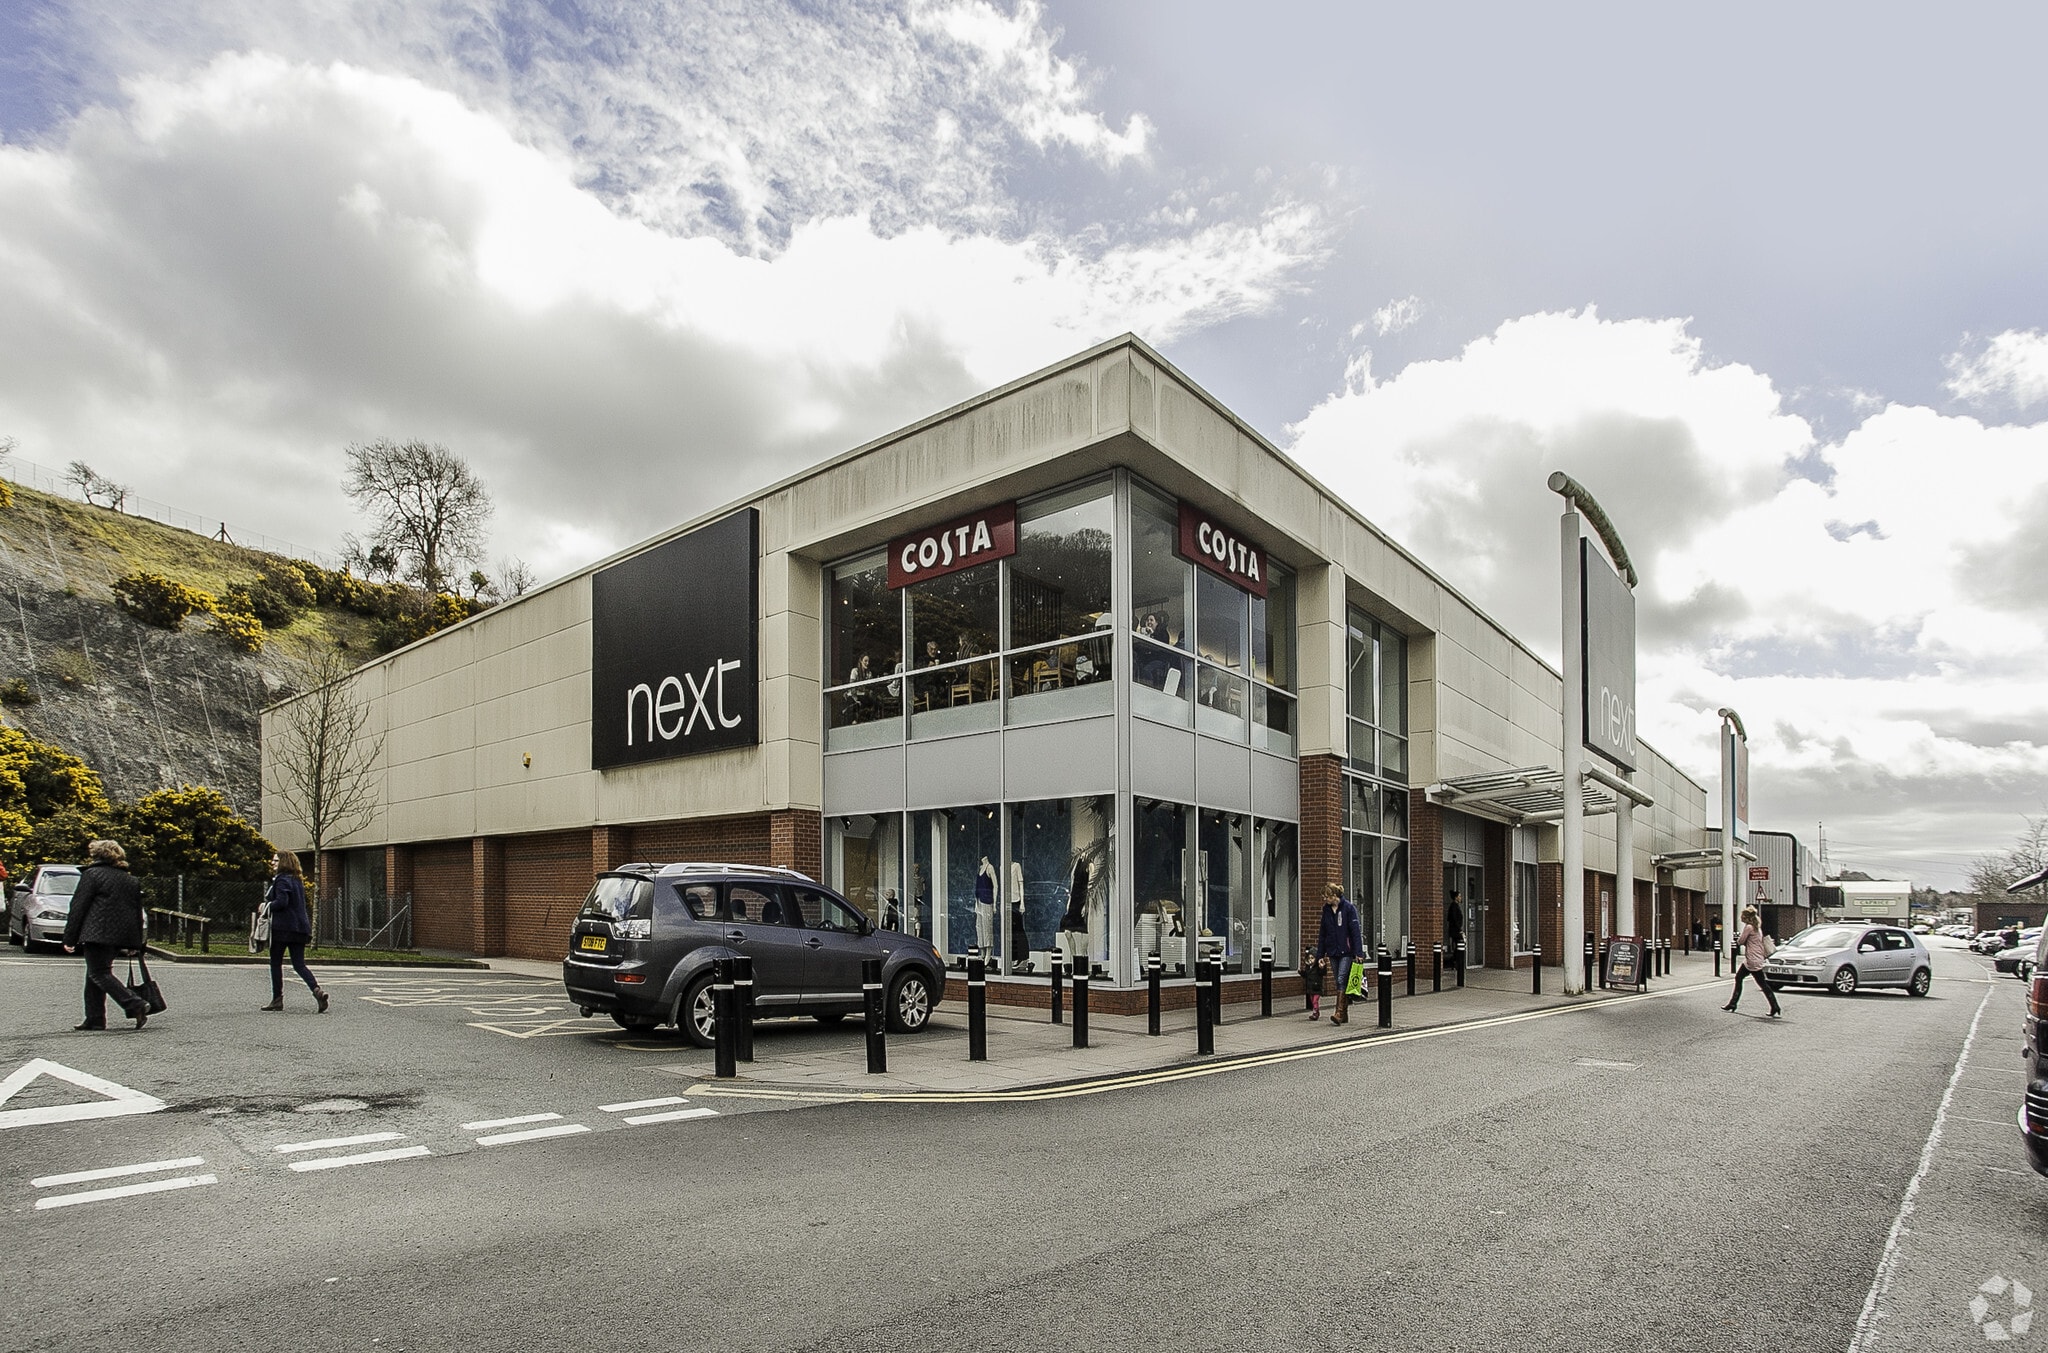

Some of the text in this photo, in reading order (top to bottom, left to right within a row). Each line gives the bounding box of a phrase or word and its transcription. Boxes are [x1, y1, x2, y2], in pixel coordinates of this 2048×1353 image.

[900, 519, 992, 574] COSTA
[1197, 521, 1260, 583] COSTA
[627, 658, 742, 747] next
[1601, 685, 1635, 757] next
